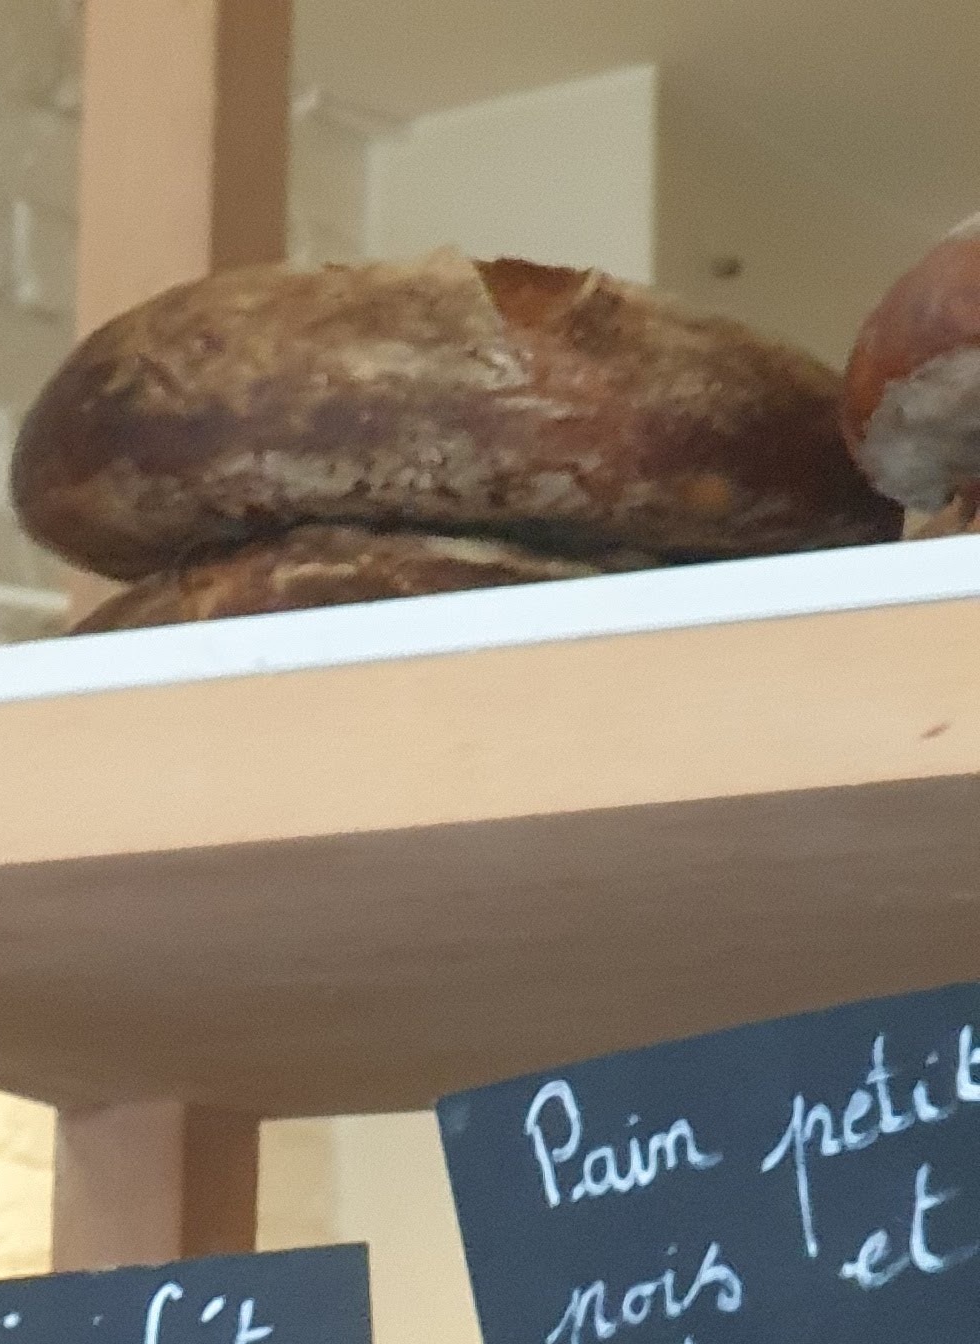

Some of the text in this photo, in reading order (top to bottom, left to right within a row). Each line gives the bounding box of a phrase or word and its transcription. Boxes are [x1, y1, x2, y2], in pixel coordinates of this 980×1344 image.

[524, 1024, 980, 1257] Pain petit
[839, 1163, 963, 1289] et
